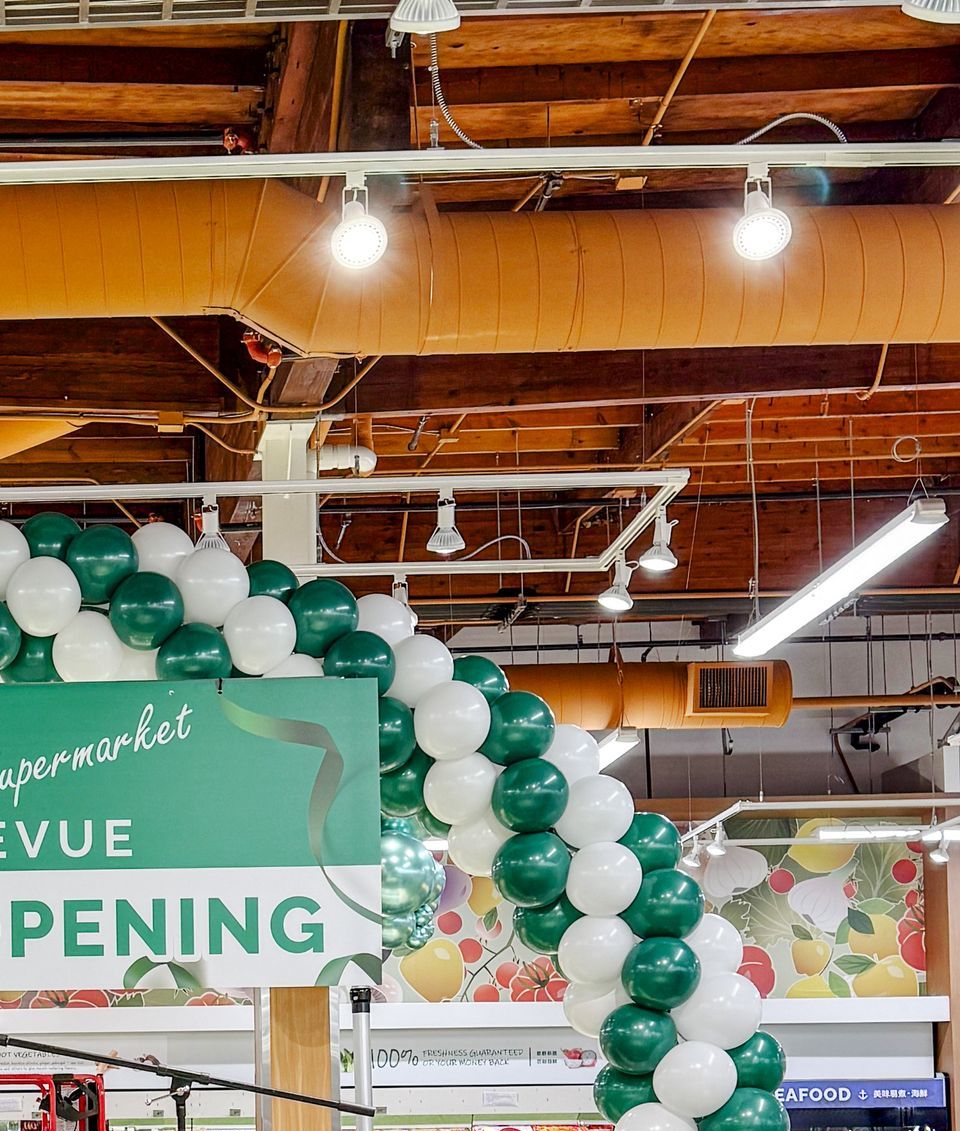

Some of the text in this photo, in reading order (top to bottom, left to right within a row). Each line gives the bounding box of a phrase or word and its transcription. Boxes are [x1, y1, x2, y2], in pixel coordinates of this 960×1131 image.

[371, 1048, 418, 1069] 100%
[422, 1048, 524, 1057] FRESHNESS GUARANTEED
[488, 1058, 509, 1066] BACK
[774, 1087, 852, 1103] EAFOOD
